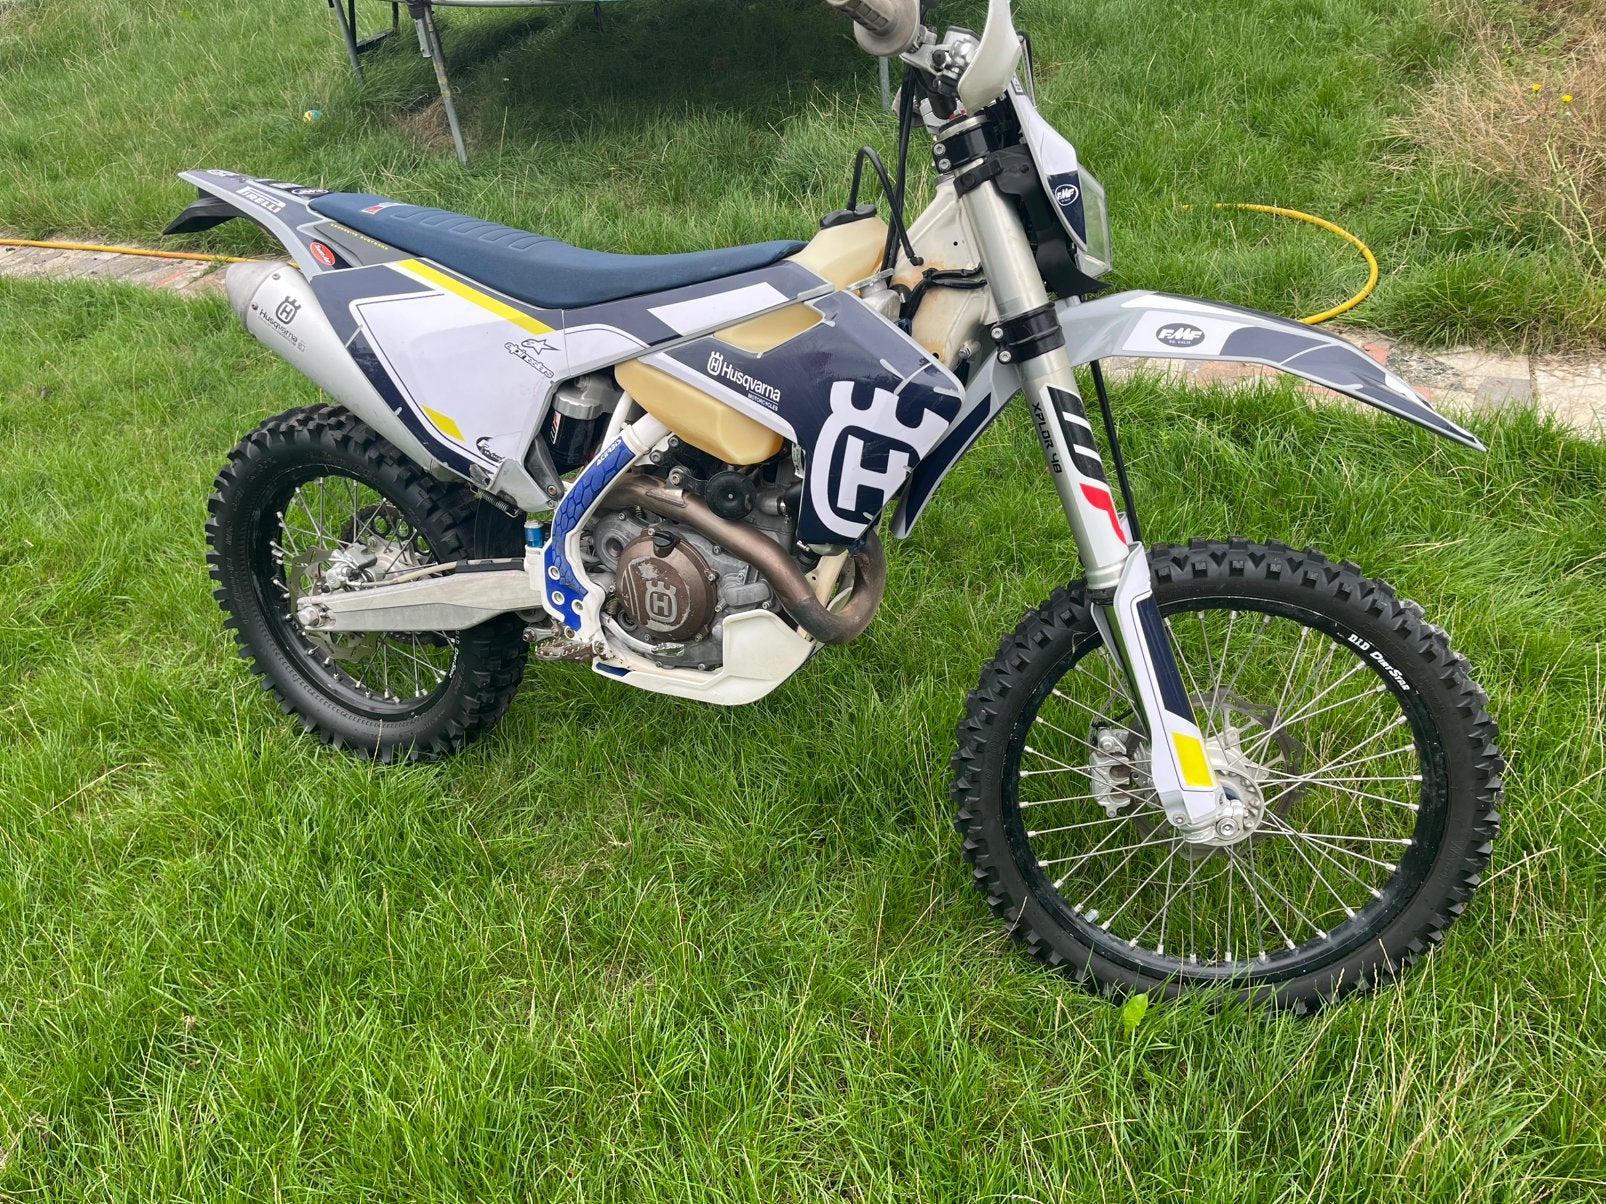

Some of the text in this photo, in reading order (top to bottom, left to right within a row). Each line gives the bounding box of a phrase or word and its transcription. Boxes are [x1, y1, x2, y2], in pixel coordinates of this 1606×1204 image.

[236, 185, 287, 213] PIRELLI
[1057, 188, 1075, 200] FMF
[259, 309, 298, 343] Husqvarna
[1158, 327, 1203, 341] FMF
[504, 342, 554, 378] alpinestars
[721, 361, 781, 402] Husqvarna
[1031, 402, 1063, 474] XPLOR 48
